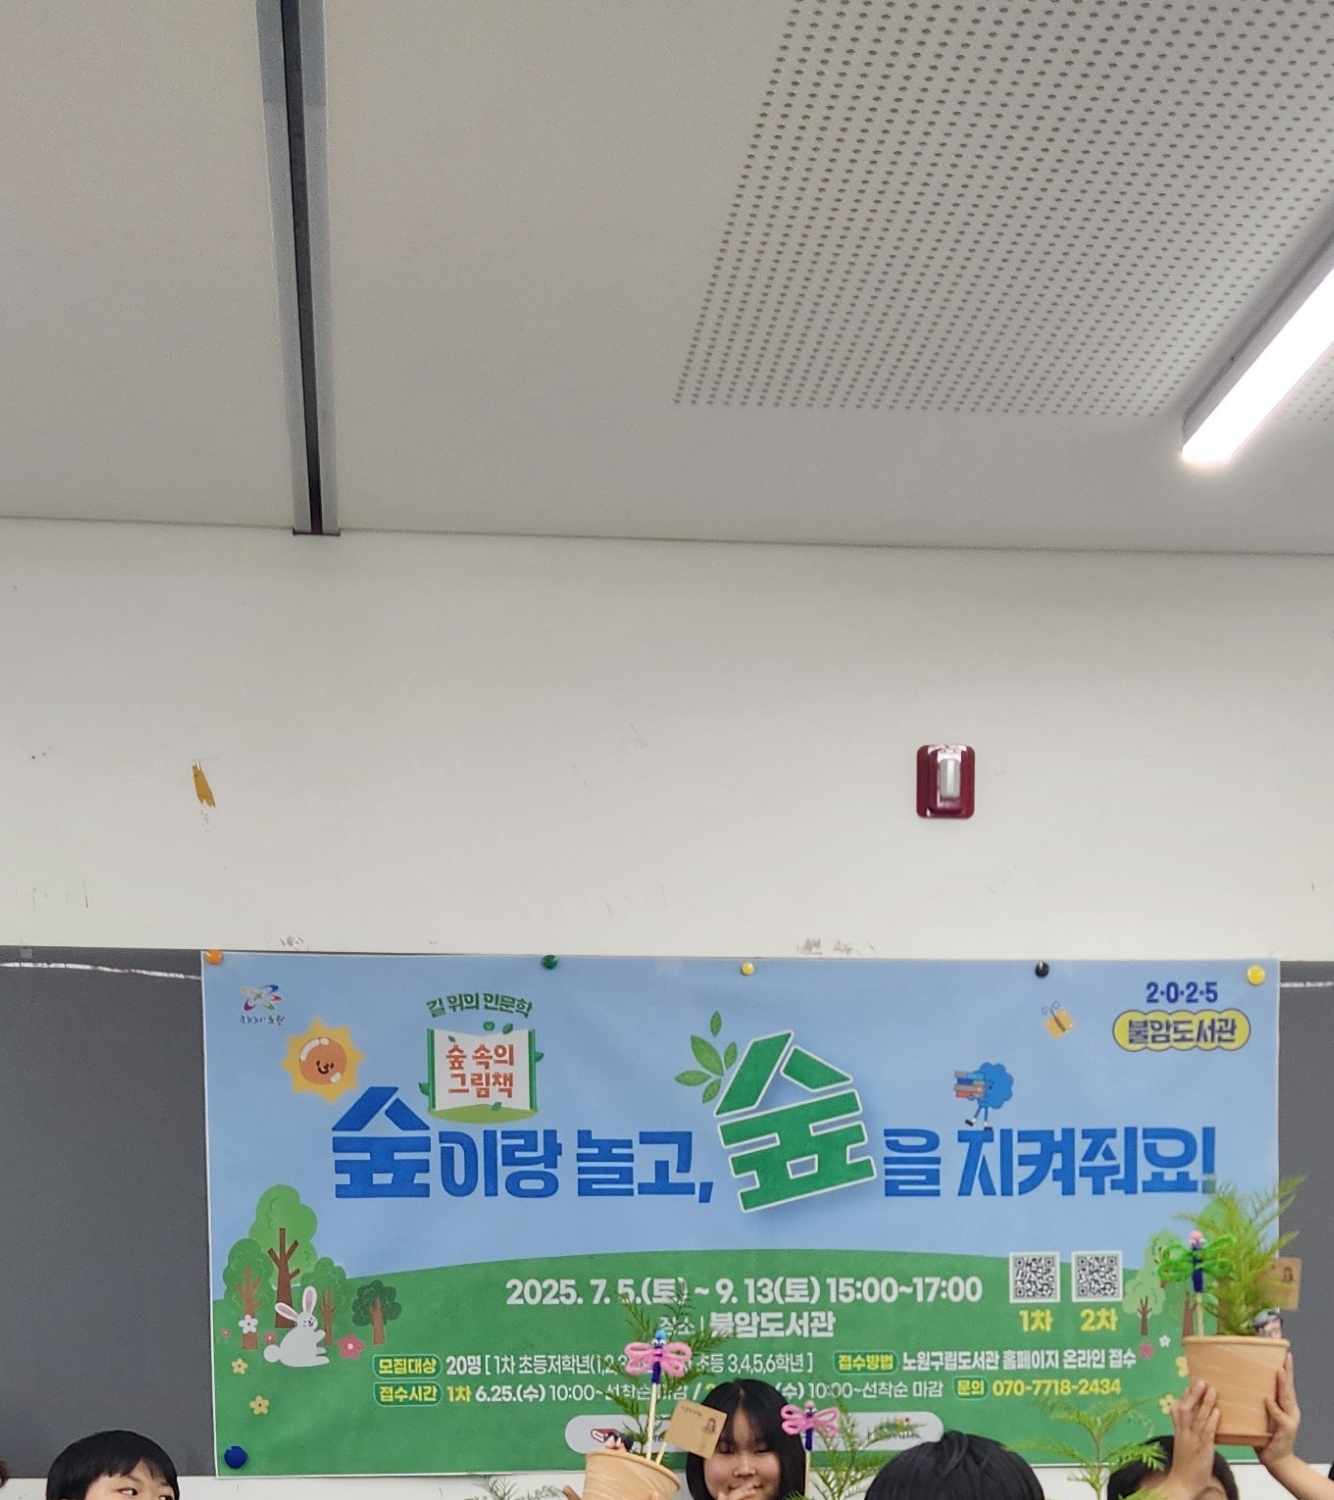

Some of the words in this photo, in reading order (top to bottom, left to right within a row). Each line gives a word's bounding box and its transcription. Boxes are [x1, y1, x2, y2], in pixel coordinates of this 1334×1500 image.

[426, 999, 448, 1019] 길
[447, 993, 480, 1012] 위의
[484, 993, 534, 1019] 인문학
[1127, 1019, 1237, 1044] 불암도서관
[446, 1044, 467, 1071] 숲
[472, 1043, 515, 1071] 속의
[447, 1071, 514, 1099] 그림책
[331, 1086, 563, 1199] 숲이랑
[575, 1128, 714, 1203] 놀고,
[957, 1125, 1217, 1197] 지켜줘요!
[505, 1278, 584, 1305] 2025.
[589, 1278, 611, 1305] 7.
[617, 1277, 689, 1306] 5.(토)
[715, 1277, 738, 1304] 9.
[743, 1276, 820, 1304] 13(토)
[825, 1275, 983, 1303] 15:00~17:00
[709, 1311, 836, 1338] 불암도서관
[1018, 1308, 1053, 1333] 1차
[1080, 1307, 1119, 1332] 2차
[378, 1357, 438, 1375] 모집대상
[446, 1355, 482, 1376] 20명
[495, 1355, 515, 1375] 1차
[727, 1352, 805, 1374] 3,4,5,6학년
[837, 1353, 894, 1371] 접수방법
[902, 1351, 1000, 1372] 노원구립도서관
[1002, 1350, 1060, 1371] 홈페이지
[1062, 1350, 1106, 1370] 온라인
[1108, 1348, 1137, 1369] 접수
[379, 1384, 438, 1402] 접수시간
[446, 1384, 472, 1403] 1차
[475, 1383, 546, 1403] 6.25.(수)
[808, 1380, 909, 1399] 10:00~선착순
[912, 1380, 944, 1399] 마감
[957, 1379, 985, 1396] 문의
[992, 1378, 1122, 1397] 070-7718-2434
